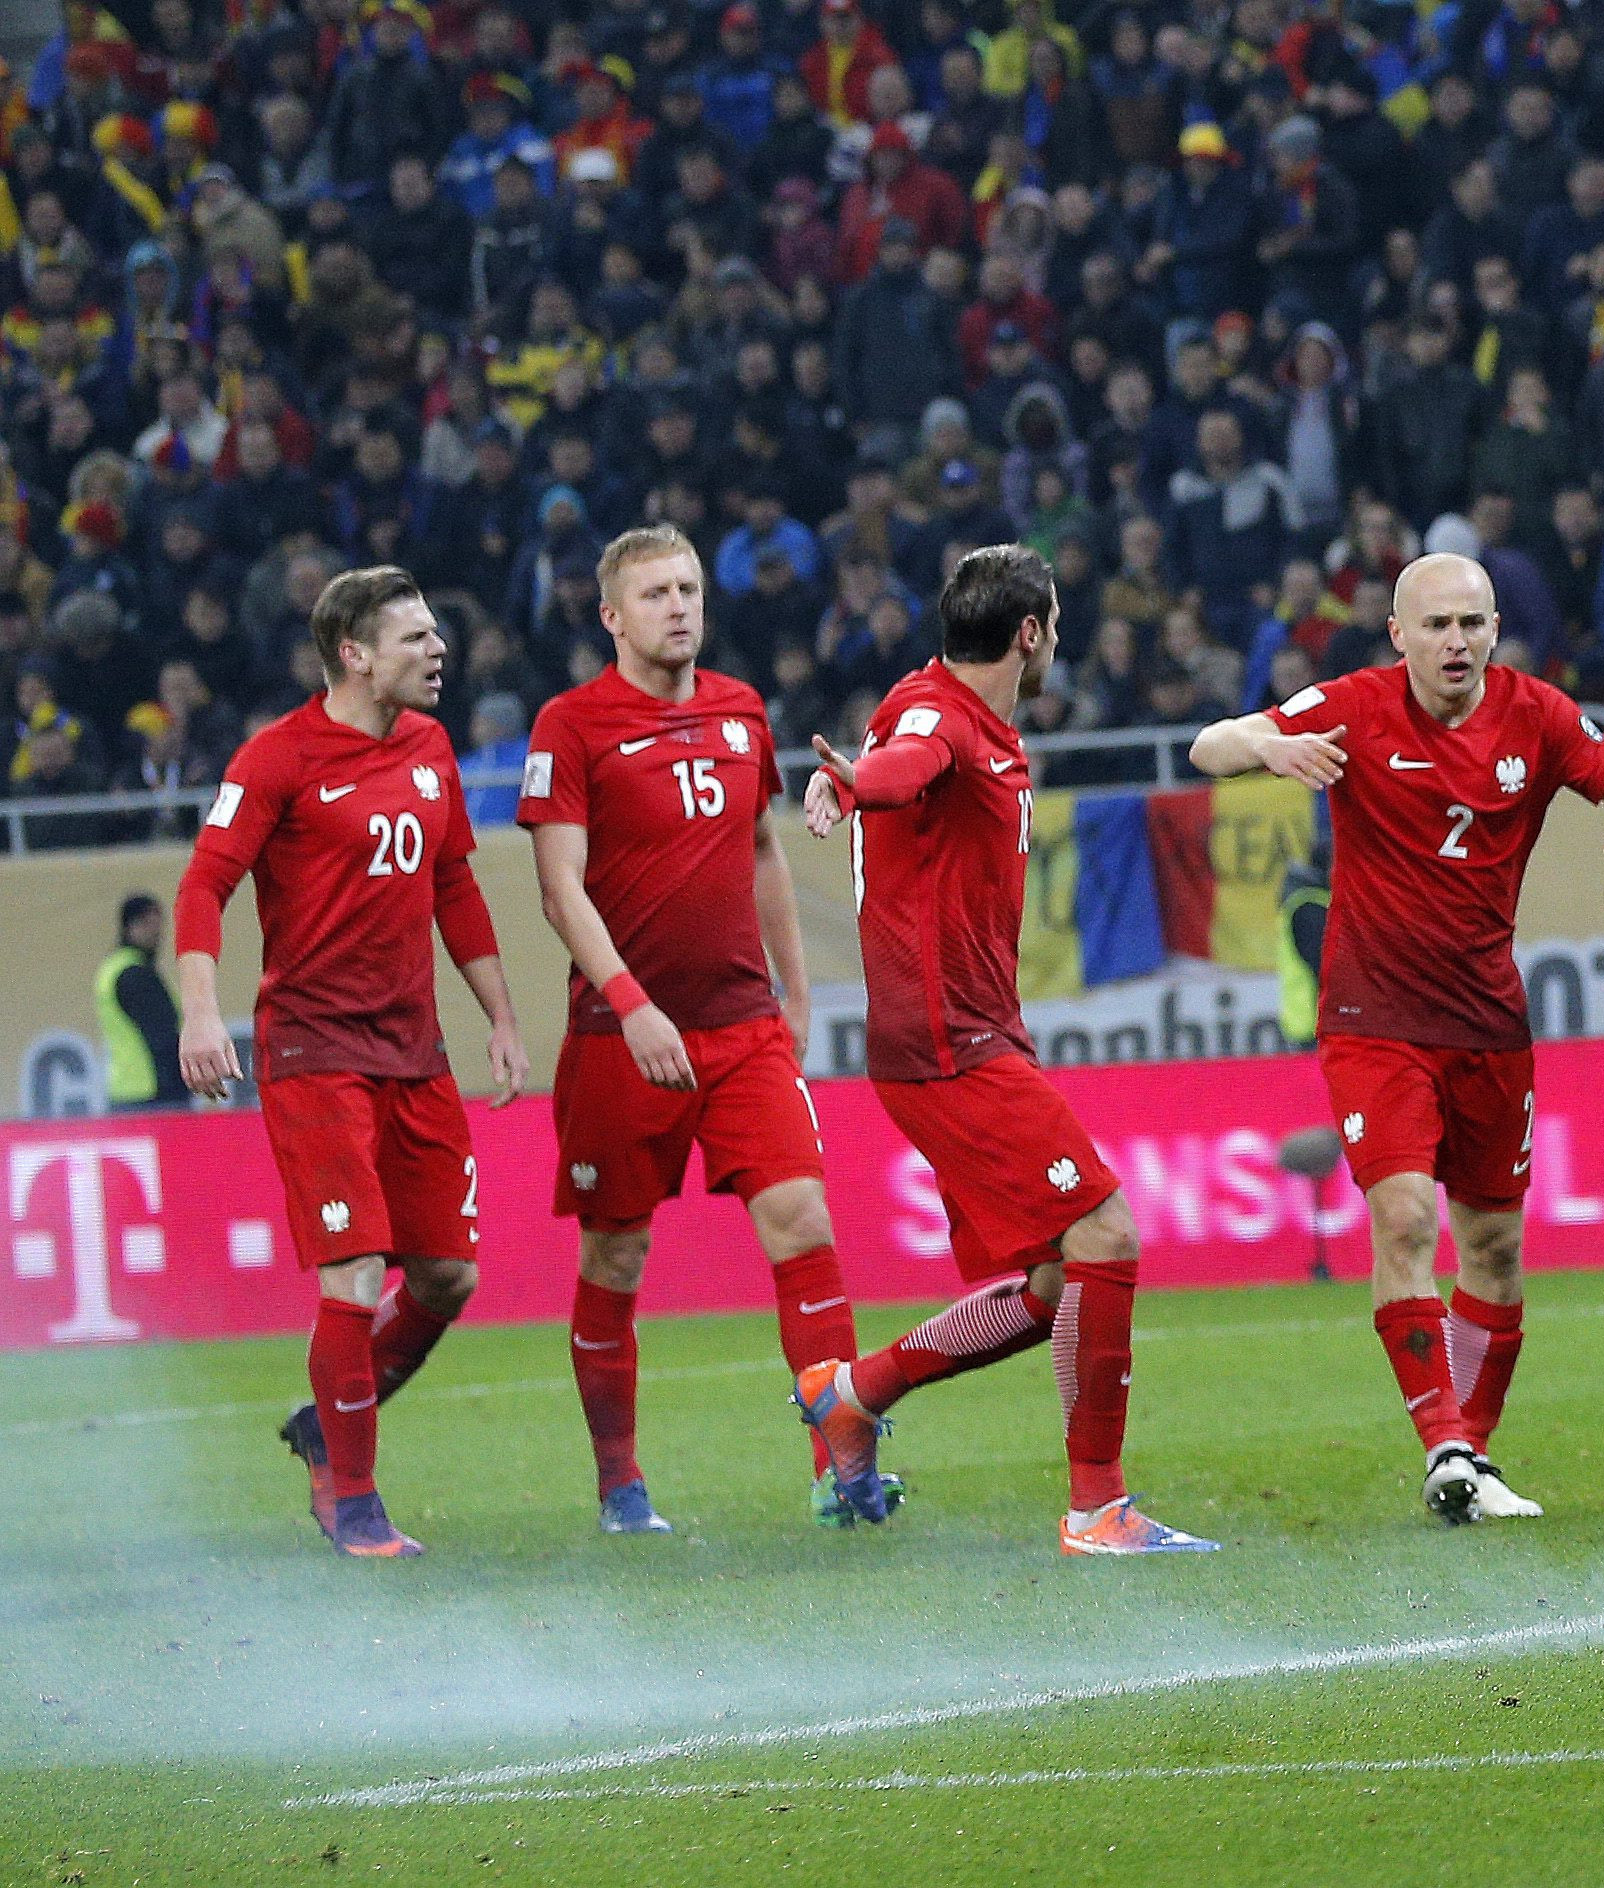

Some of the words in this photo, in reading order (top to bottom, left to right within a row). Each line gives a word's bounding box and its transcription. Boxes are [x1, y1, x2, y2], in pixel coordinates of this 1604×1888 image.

[672, 758, 725, 820] 15
[367, 811, 424, 876] 20
[1438, 804, 1474, 859] 2
[10, 1136, 163, 1342] T
